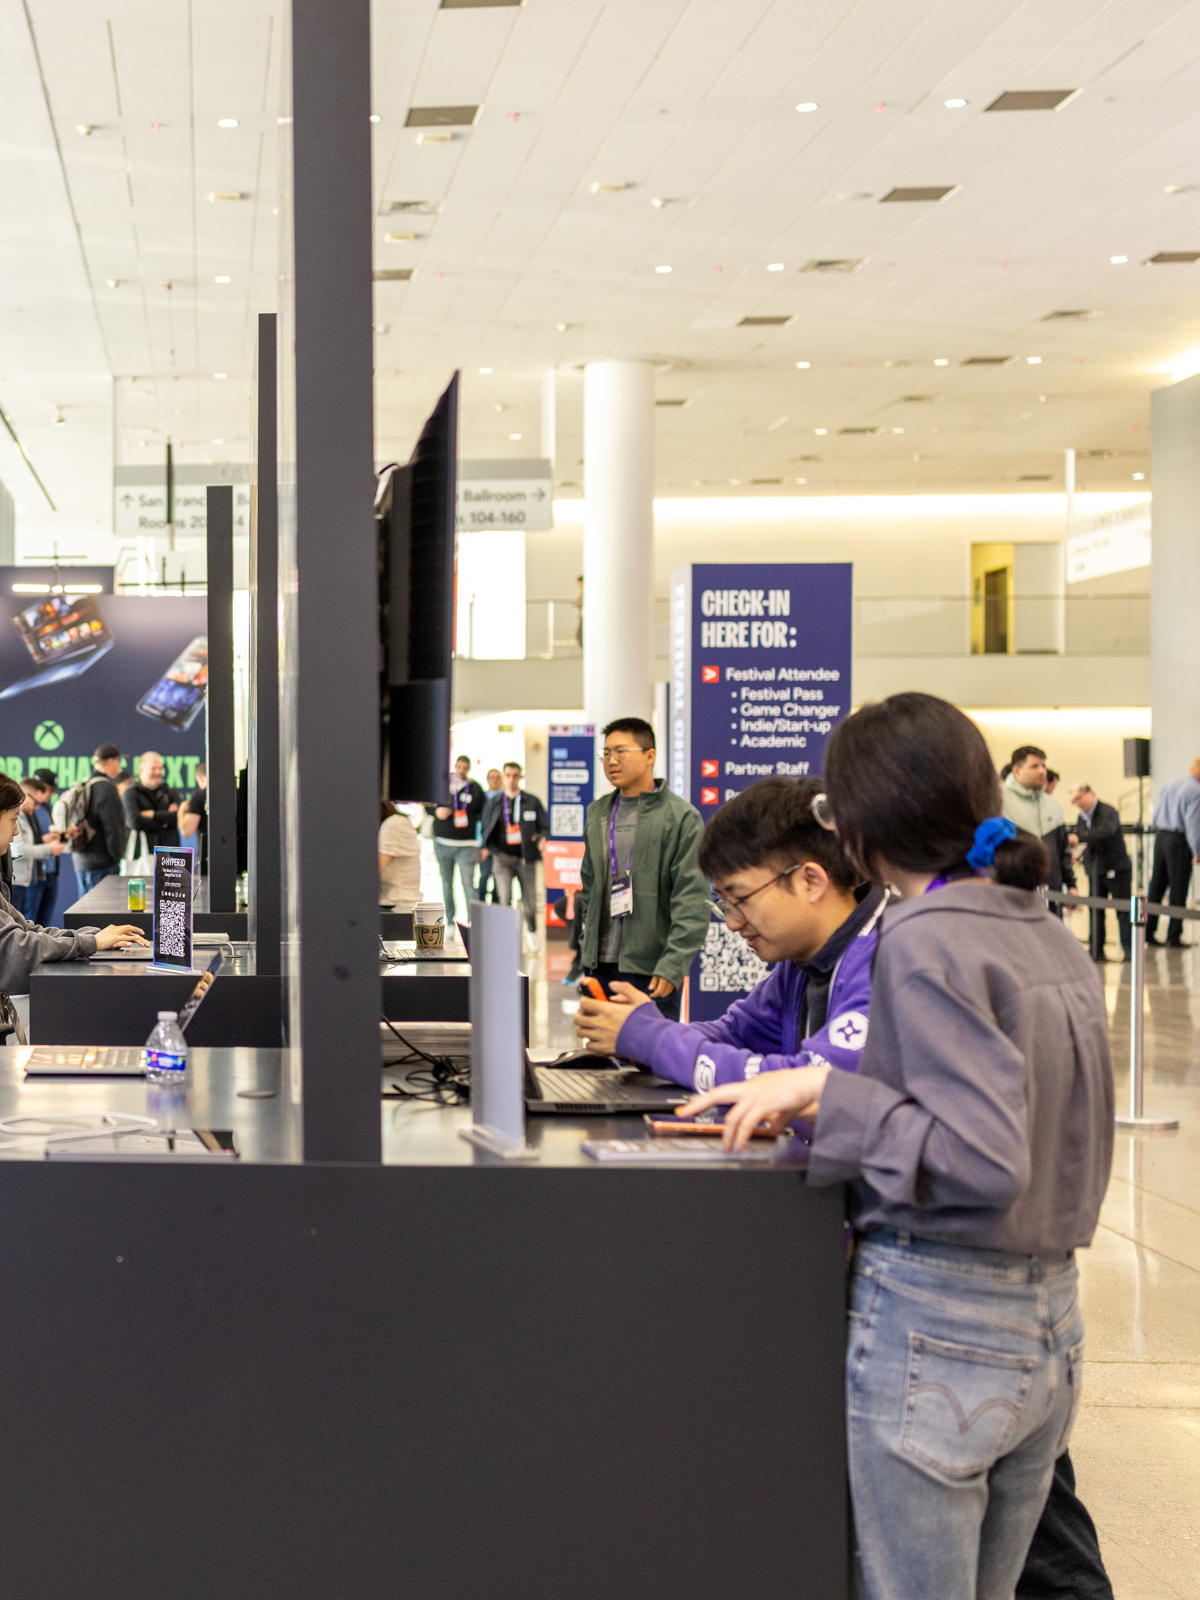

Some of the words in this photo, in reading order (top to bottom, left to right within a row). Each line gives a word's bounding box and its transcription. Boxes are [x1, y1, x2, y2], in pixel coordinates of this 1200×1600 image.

[138, 494, 164, 508] San
[463, 488, 527, 503] Ballroom
[470, 510, 527, 524] 104-160
[701, 589, 790, 617] CHECK-IN
[701, 621, 749, 648] HERE
[750, 621, 798, 648] FOR:
[726, 667, 775, 681] Festival
[777, 667, 840, 681] Attendee
[740, 687, 791, 701] Festival
[793, 687, 824, 701] Pass
[740, 703, 781, 716] Game
[783, 703, 840, 719] Changer
[740, 719, 832, 735] Indie/Start-up
[740, 734, 807, 748] Academic
[674, 717, 686, 799] CHEC
[725, 762, 774, 775] Partner
[775, 761, 810, 775] Staff
